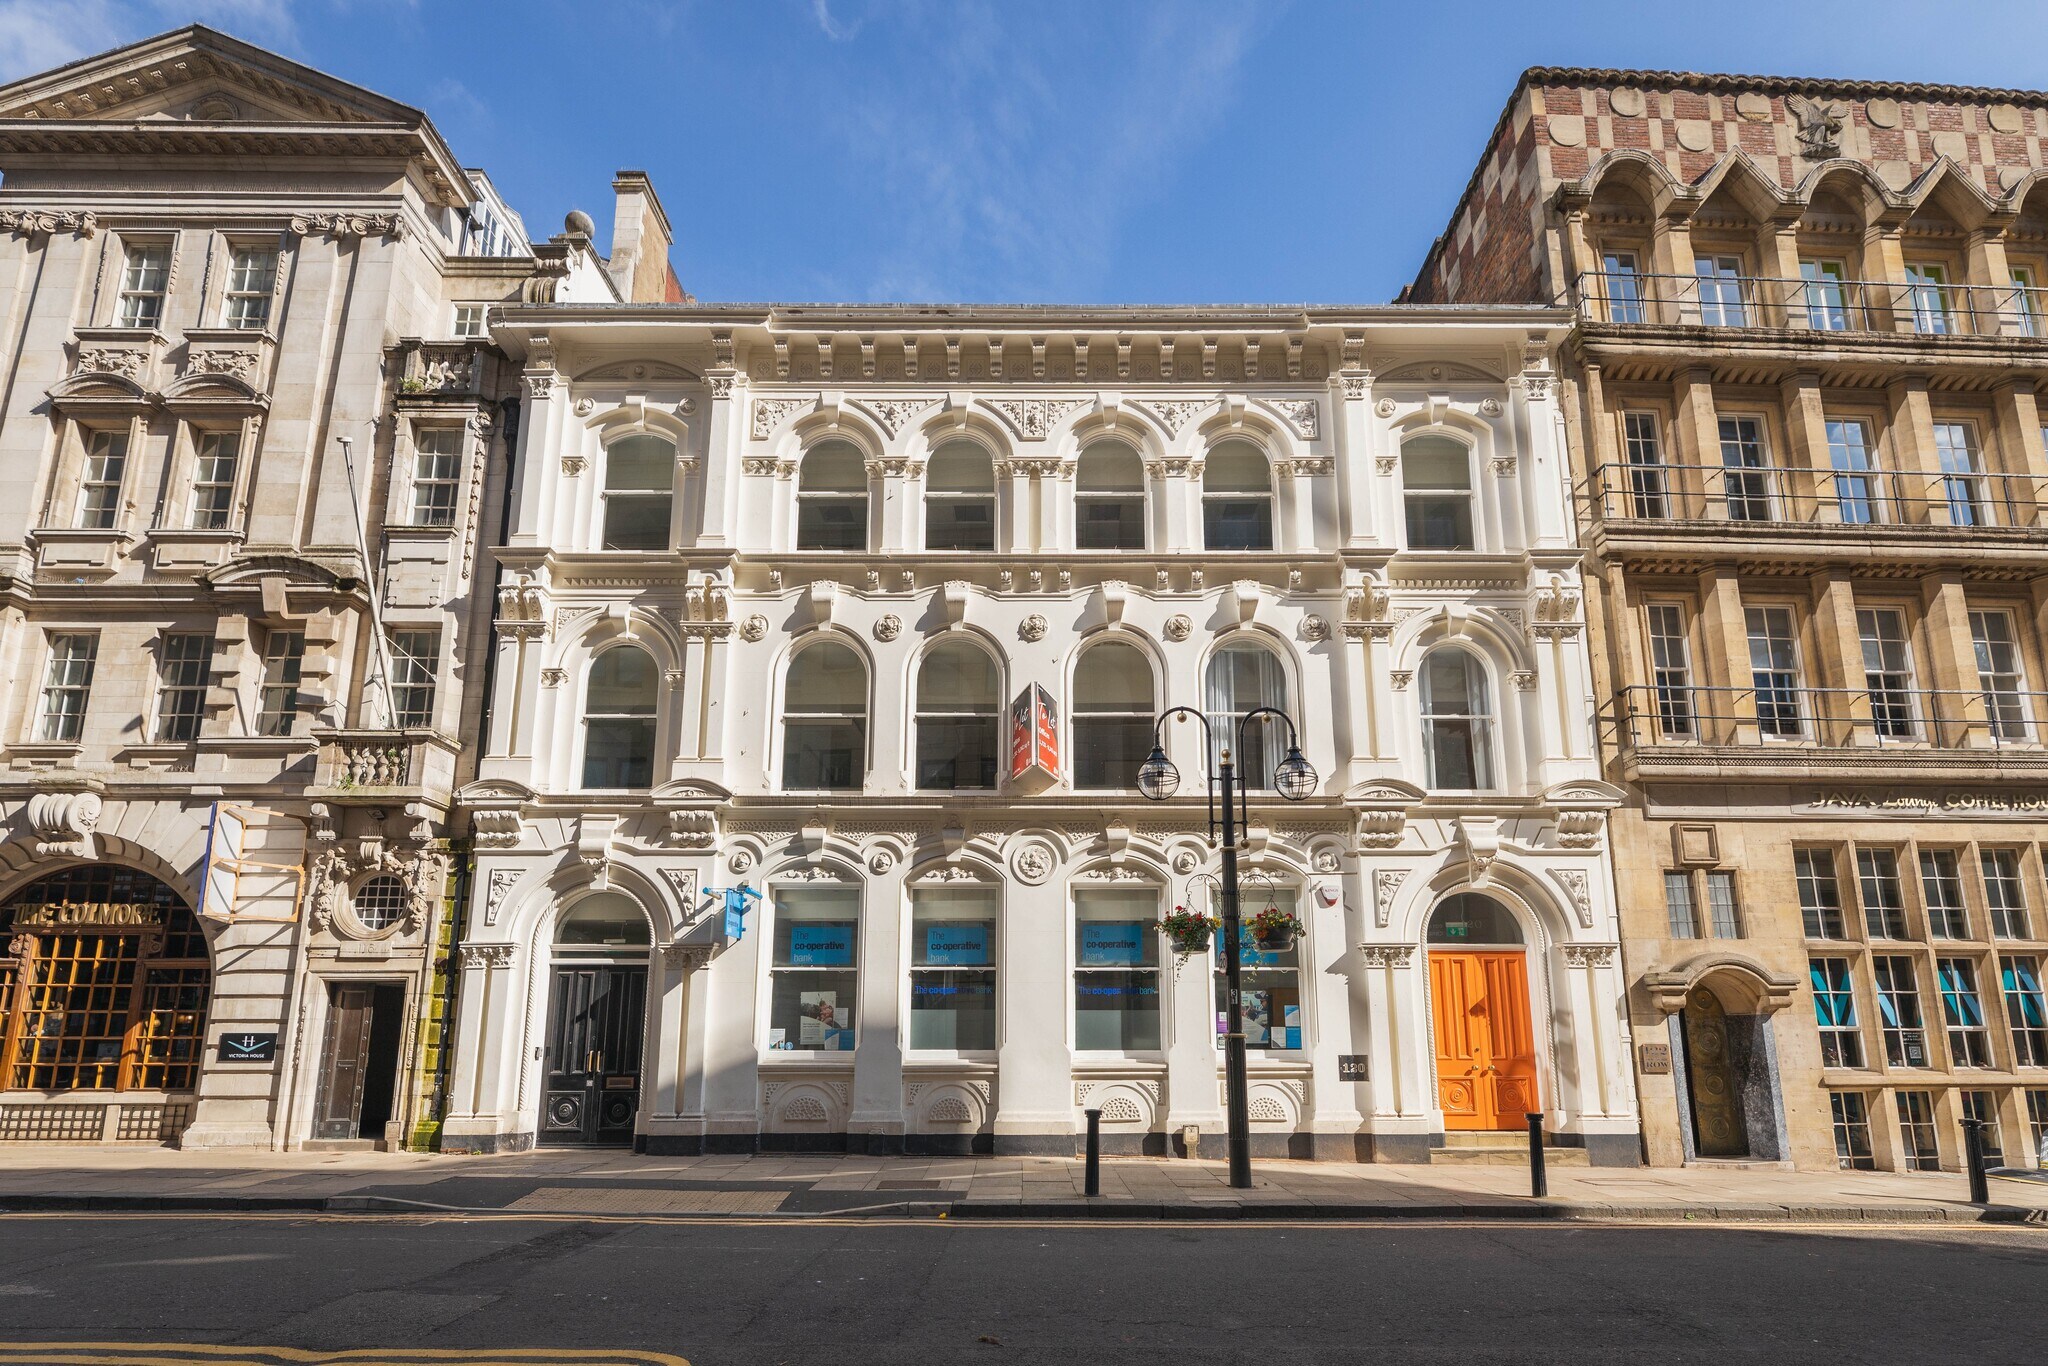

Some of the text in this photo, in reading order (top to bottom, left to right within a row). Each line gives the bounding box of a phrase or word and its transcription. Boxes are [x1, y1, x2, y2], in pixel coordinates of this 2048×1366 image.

[1811, 791, 1877, 806] JAVA
[1882, 790, 1939, 814] Lounge
[1945, 793, 2009, 809] COFFEE
[13, 903, 161, 925] THE COLMORE
[795, 931, 809, 940] The
[931, 931, 945, 940] The
[1086, 929, 1100, 938] The
[794, 941, 845, 952] co-operative
[931, 941, 981, 952] co-operative
[1086, 939, 1137, 950] co-operative
[793, 953, 813, 963] bank
[930, 954, 950, 963] bank
[1085, 952, 1105, 961] bank
[915, 985, 927, 994] The
[975, 985, 993, 994] bank
[1079, 985, 1091, 995] The
[1139, 986, 1156, 995] bank
[1342, 1062, 1366, 1073] 120
